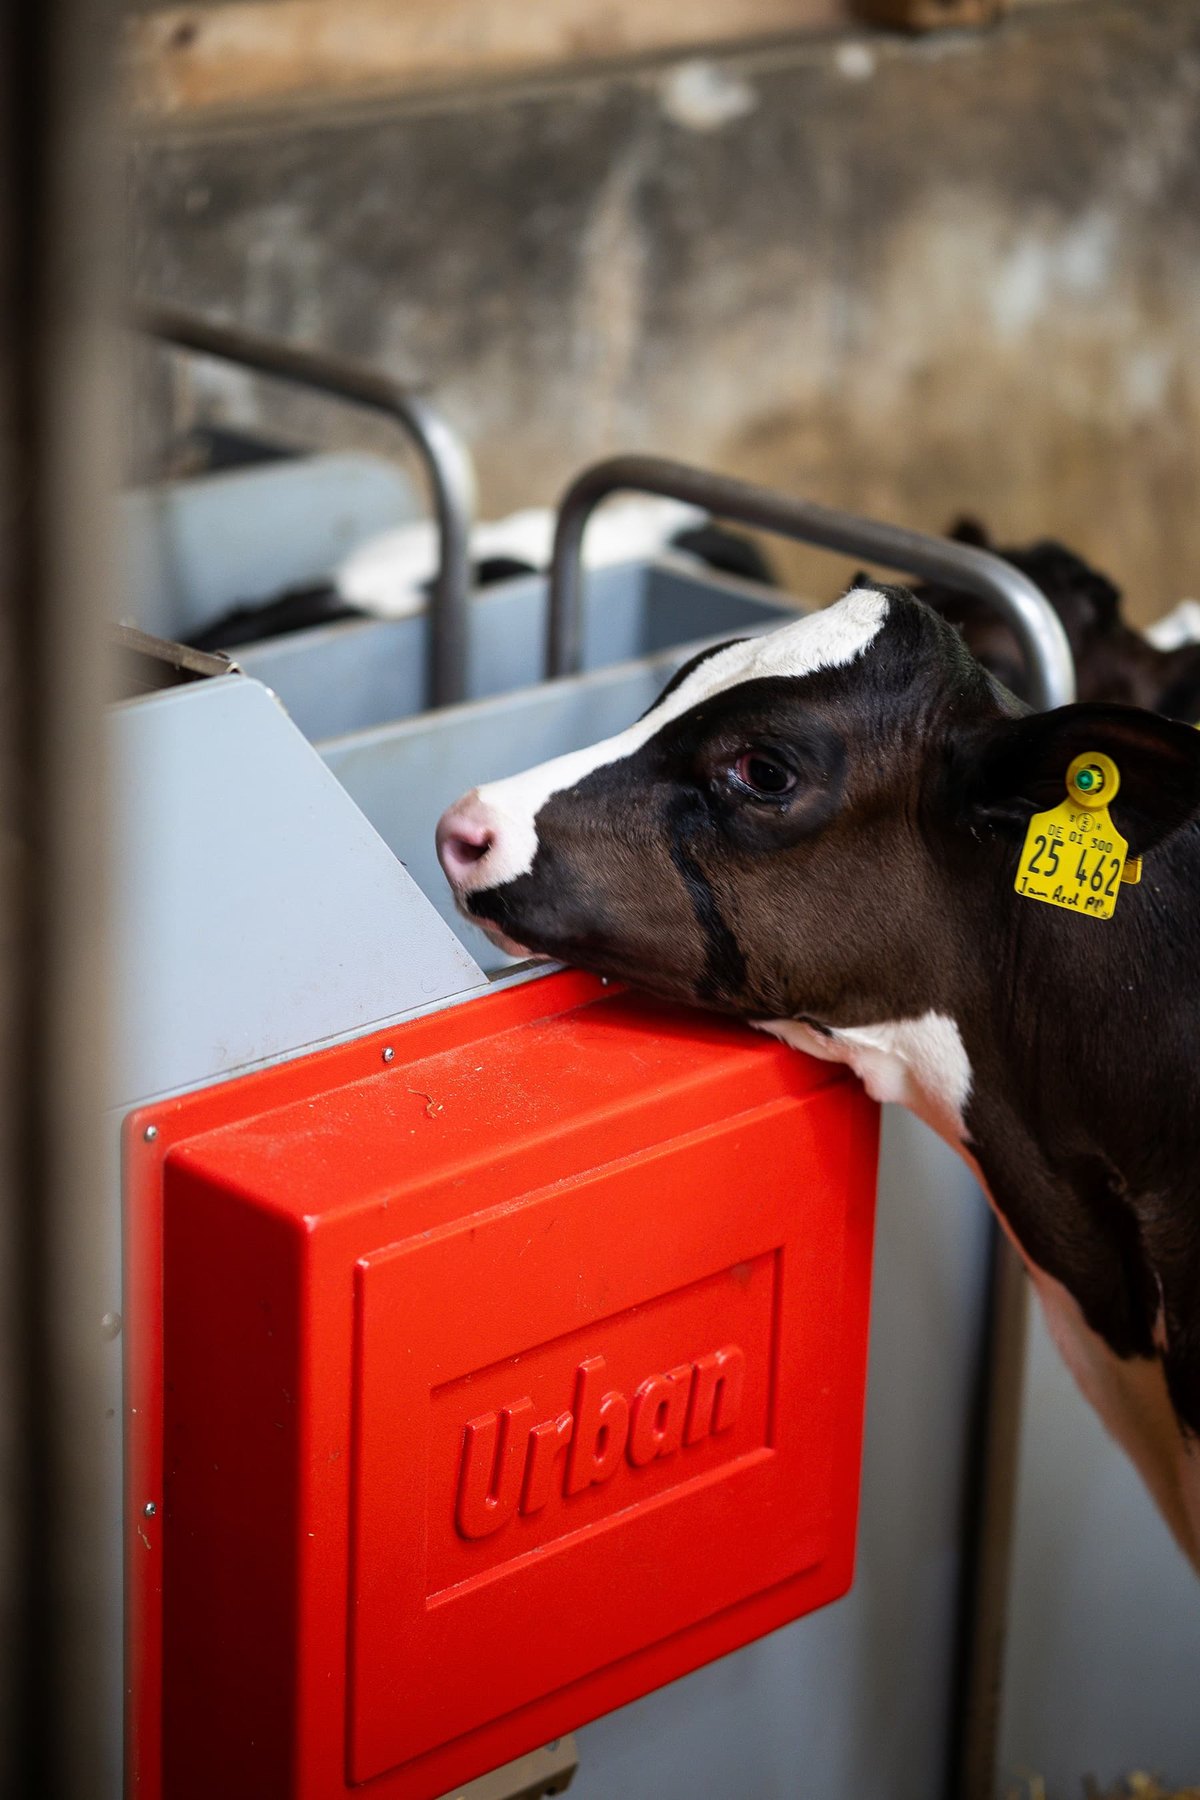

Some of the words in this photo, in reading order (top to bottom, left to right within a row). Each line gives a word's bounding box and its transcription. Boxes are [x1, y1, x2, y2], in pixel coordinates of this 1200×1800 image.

[1027, 834, 1064, 877] 25
[1075, 849, 1121, 897] 462
[1048, 824, 1064, 838] DE
[1069, 831, 1083, 845] 01
[1090, 837, 1113, 853] 300
[455, 1345, 745, 1541] Urban
